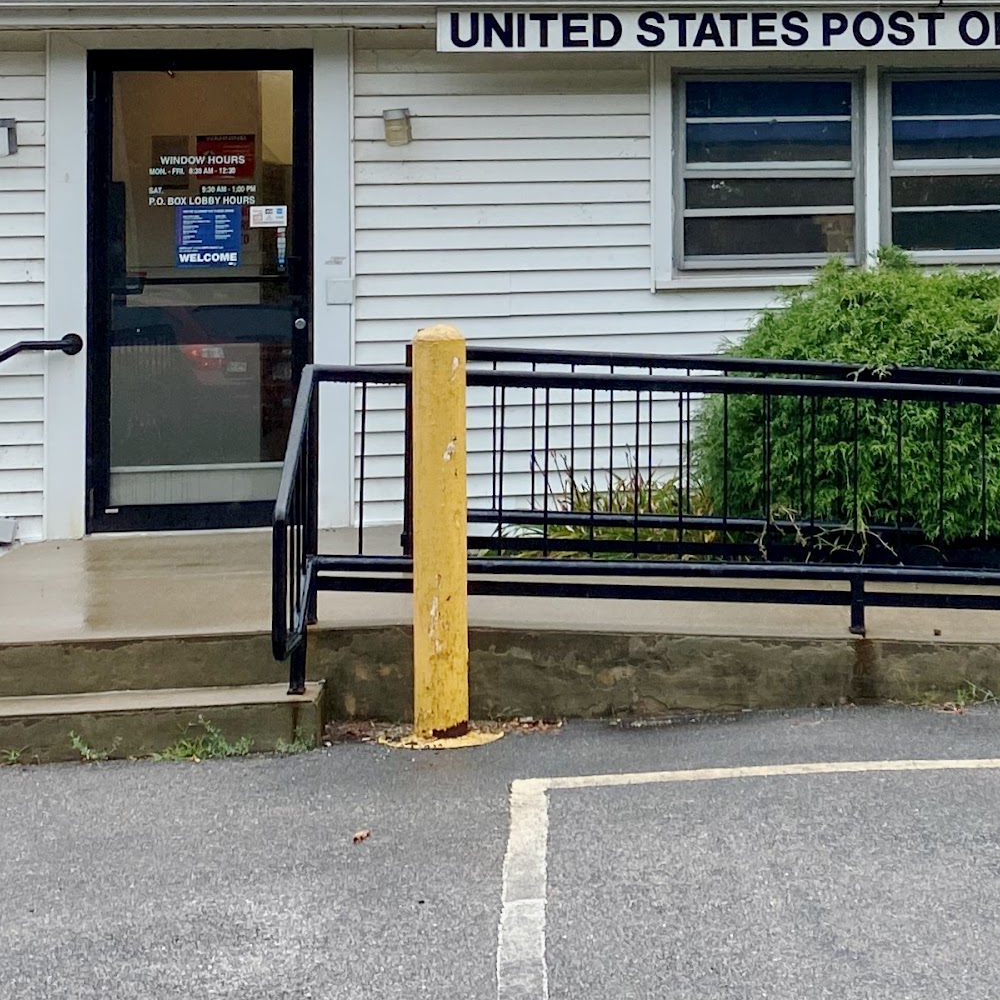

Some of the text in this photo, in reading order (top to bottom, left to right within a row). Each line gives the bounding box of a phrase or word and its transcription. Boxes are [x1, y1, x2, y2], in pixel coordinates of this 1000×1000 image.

[450, 12, 622, 48] UNITED
[636, 11, 809, 48] STATES
[822, 10, 945, 47] POST
[160, 155, 245, 165] WINDOW HOURS
[149, 186, 164, 194] SAT.
[149, 196, 255, 206] P.O. BOX LOBBY HOURS
[179, 253, 237, 262] WELCOME
